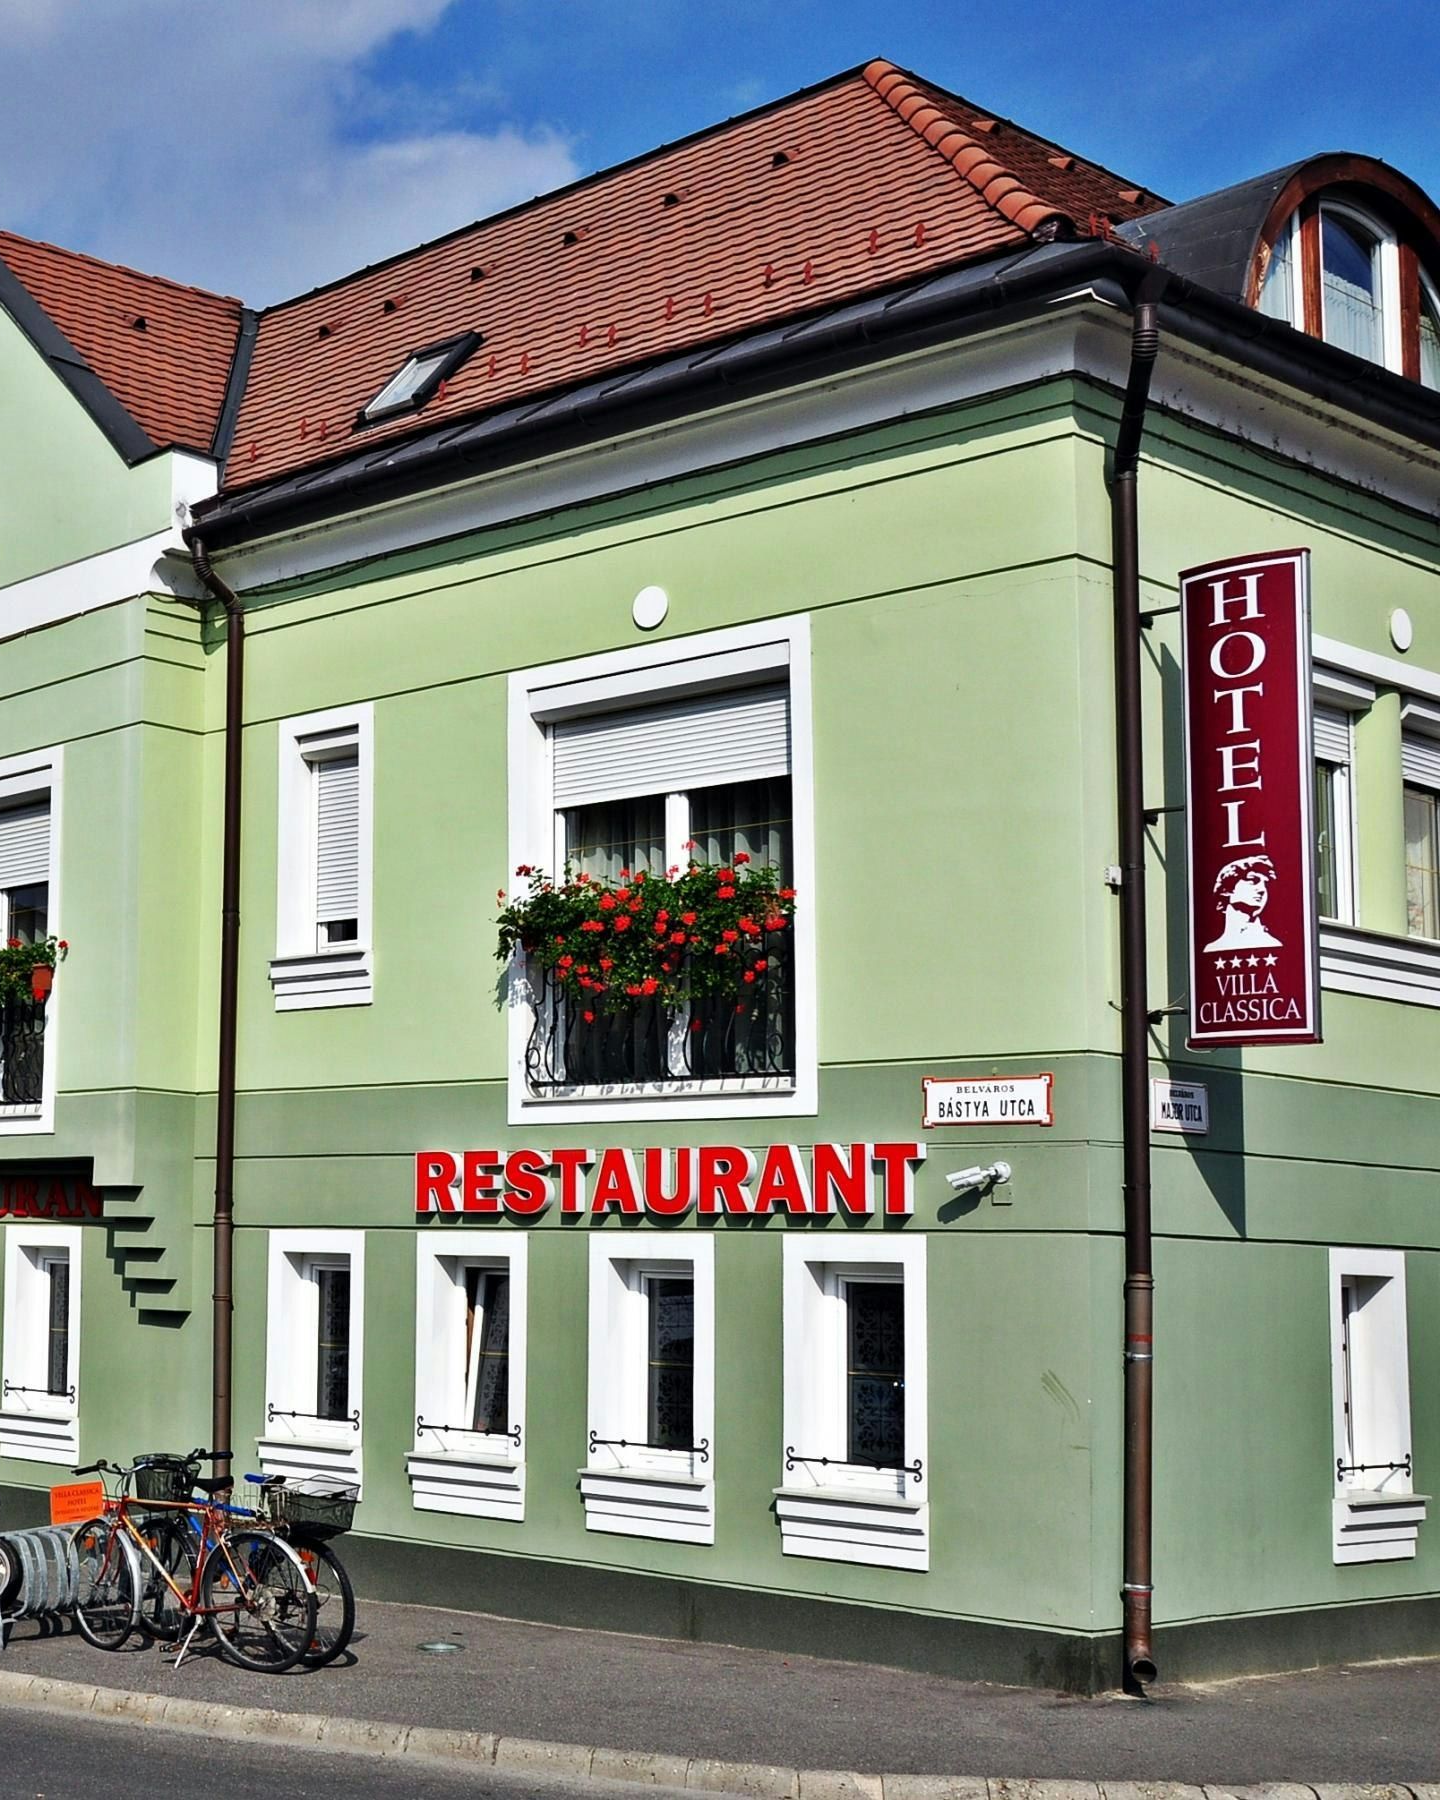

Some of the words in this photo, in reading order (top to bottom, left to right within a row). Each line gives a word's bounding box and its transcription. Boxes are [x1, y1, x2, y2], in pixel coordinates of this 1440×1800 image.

[1207, 572, 1267, 848] HOTEL
[1216, 972, 1280, 997] VILLA
[1200, 997, 1303, 1025] CLASSICA
[956, 1083, 1015, 1094] BELVÁROS
[938, 1097, 990, 1118] BÁSTYA
[1000, 1099, 1035, 1117] UTCA
[1185, 1103, 1203, 1122] UTCA
[415, 1143, 926, 1215] RESTAURANT
